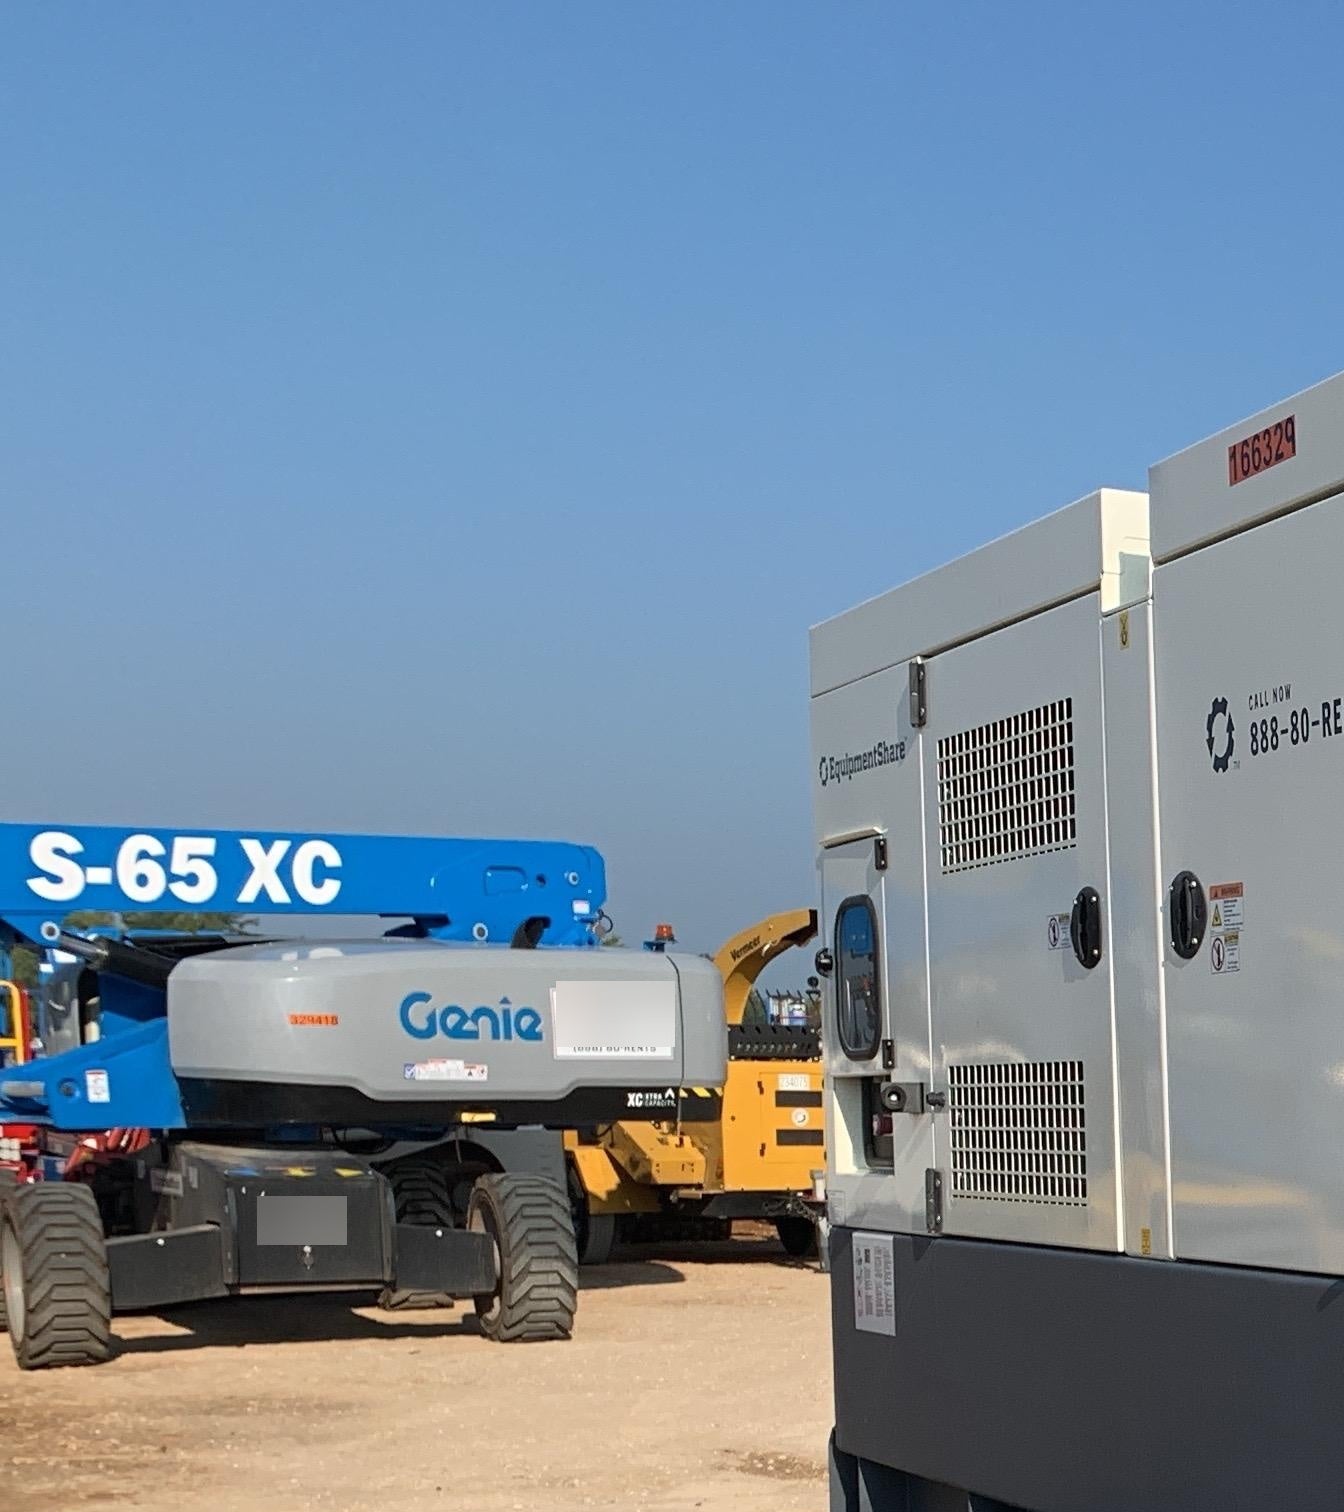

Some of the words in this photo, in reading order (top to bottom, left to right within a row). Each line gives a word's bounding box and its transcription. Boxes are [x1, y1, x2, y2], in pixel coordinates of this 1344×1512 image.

[1229, 416, 1296, 482] 166329
[1248, 690, 1269, 711] CALL
[1273, 684, 1292, 703] NOW
[829, 741, 906, 784] EquipmentShare
[25, 831, 219, 904] S-65
[236, 838, 343, 906] XC
[399, 991, 544, 1042] Genie
[627, 1092, 643, 1108] XC
